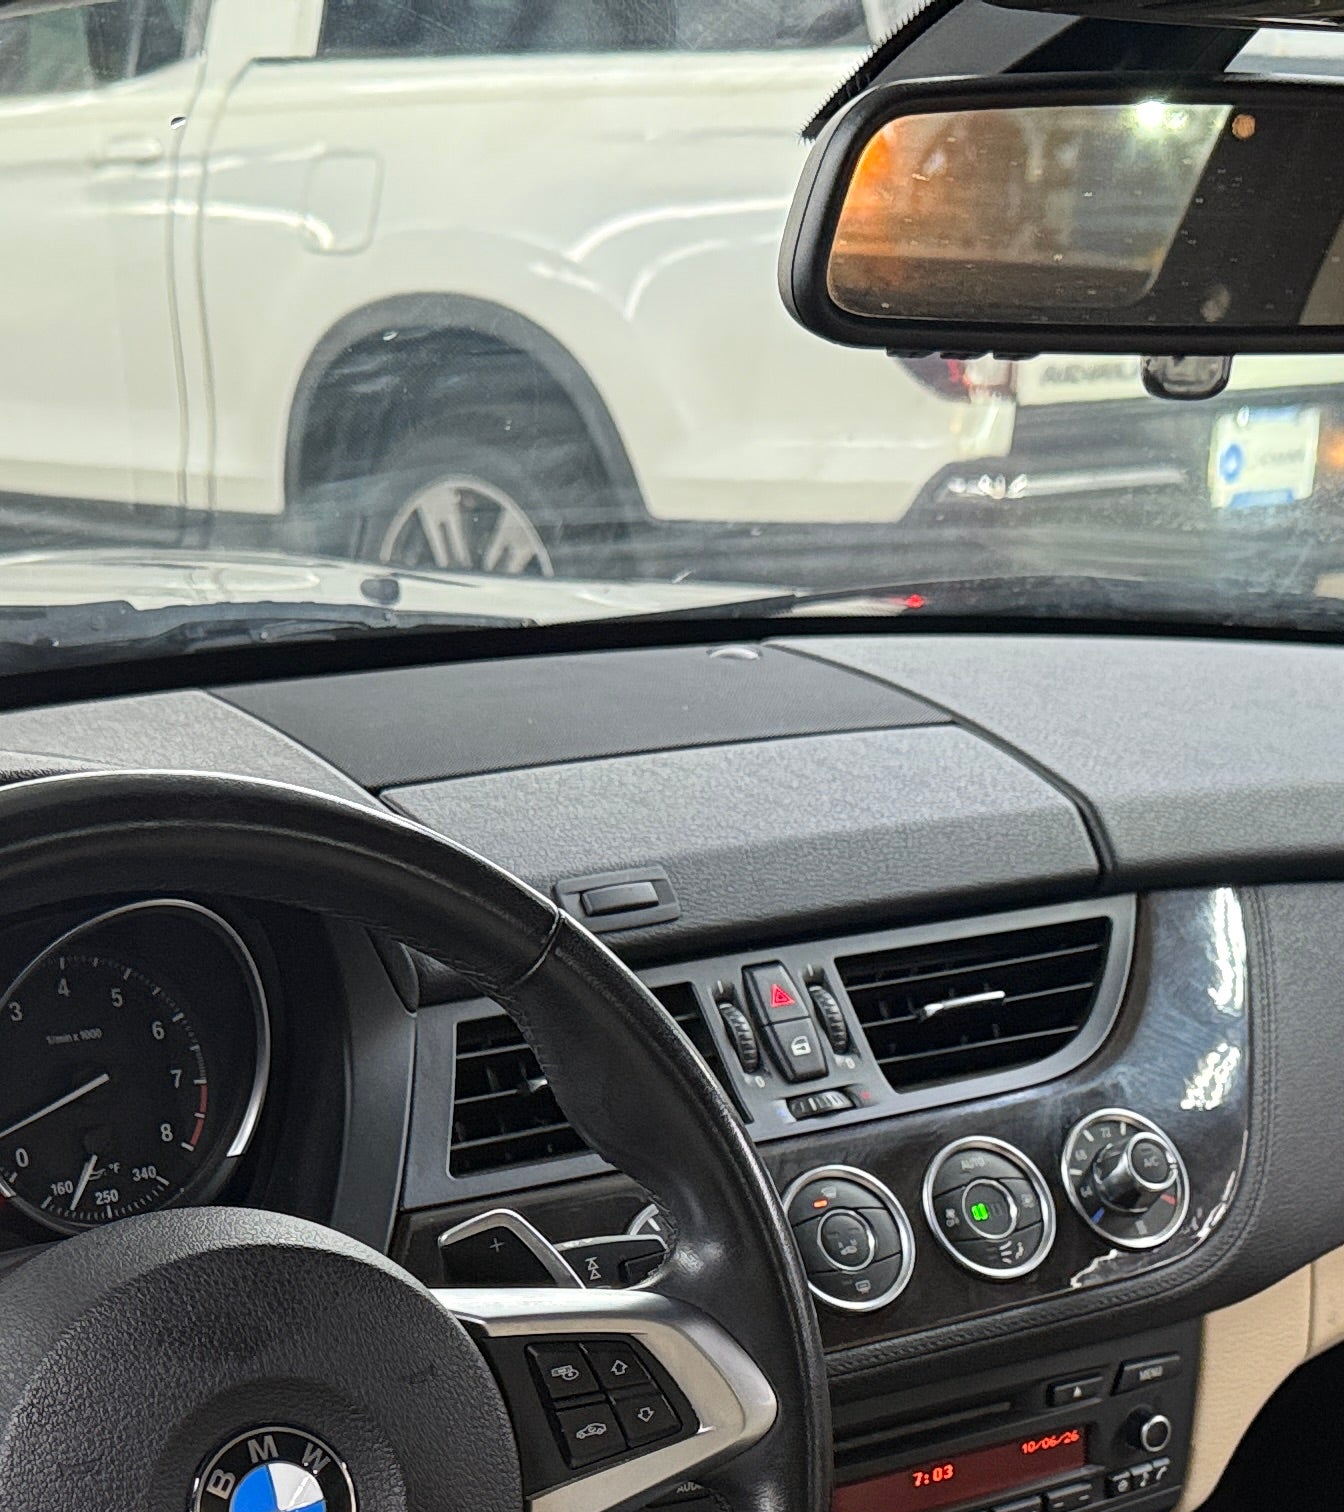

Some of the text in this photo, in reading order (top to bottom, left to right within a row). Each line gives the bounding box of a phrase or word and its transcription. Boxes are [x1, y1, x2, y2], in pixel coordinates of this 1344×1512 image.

[58, 978, 71, 997] 4
[110, 988, 123, 1008] 5
[9, 1002, 23, 1022] 3
[152, 1021, 165, 1040] 6
[170, 1069, 183, 1088] 7
[160, 1123, 173, 1142] 8
[15, 1148, 29, 1167] 0
[132, 1166, 157, 1181] 340
[51, 1180, 74, 1197] 160
[95, 1189, 119, 1205] 250
[1021, 1429, 1080, 1454] 10/06/26
[206, 1434, 331, 1500] BMW
[912, 1464, 954, 1487] 7:03
